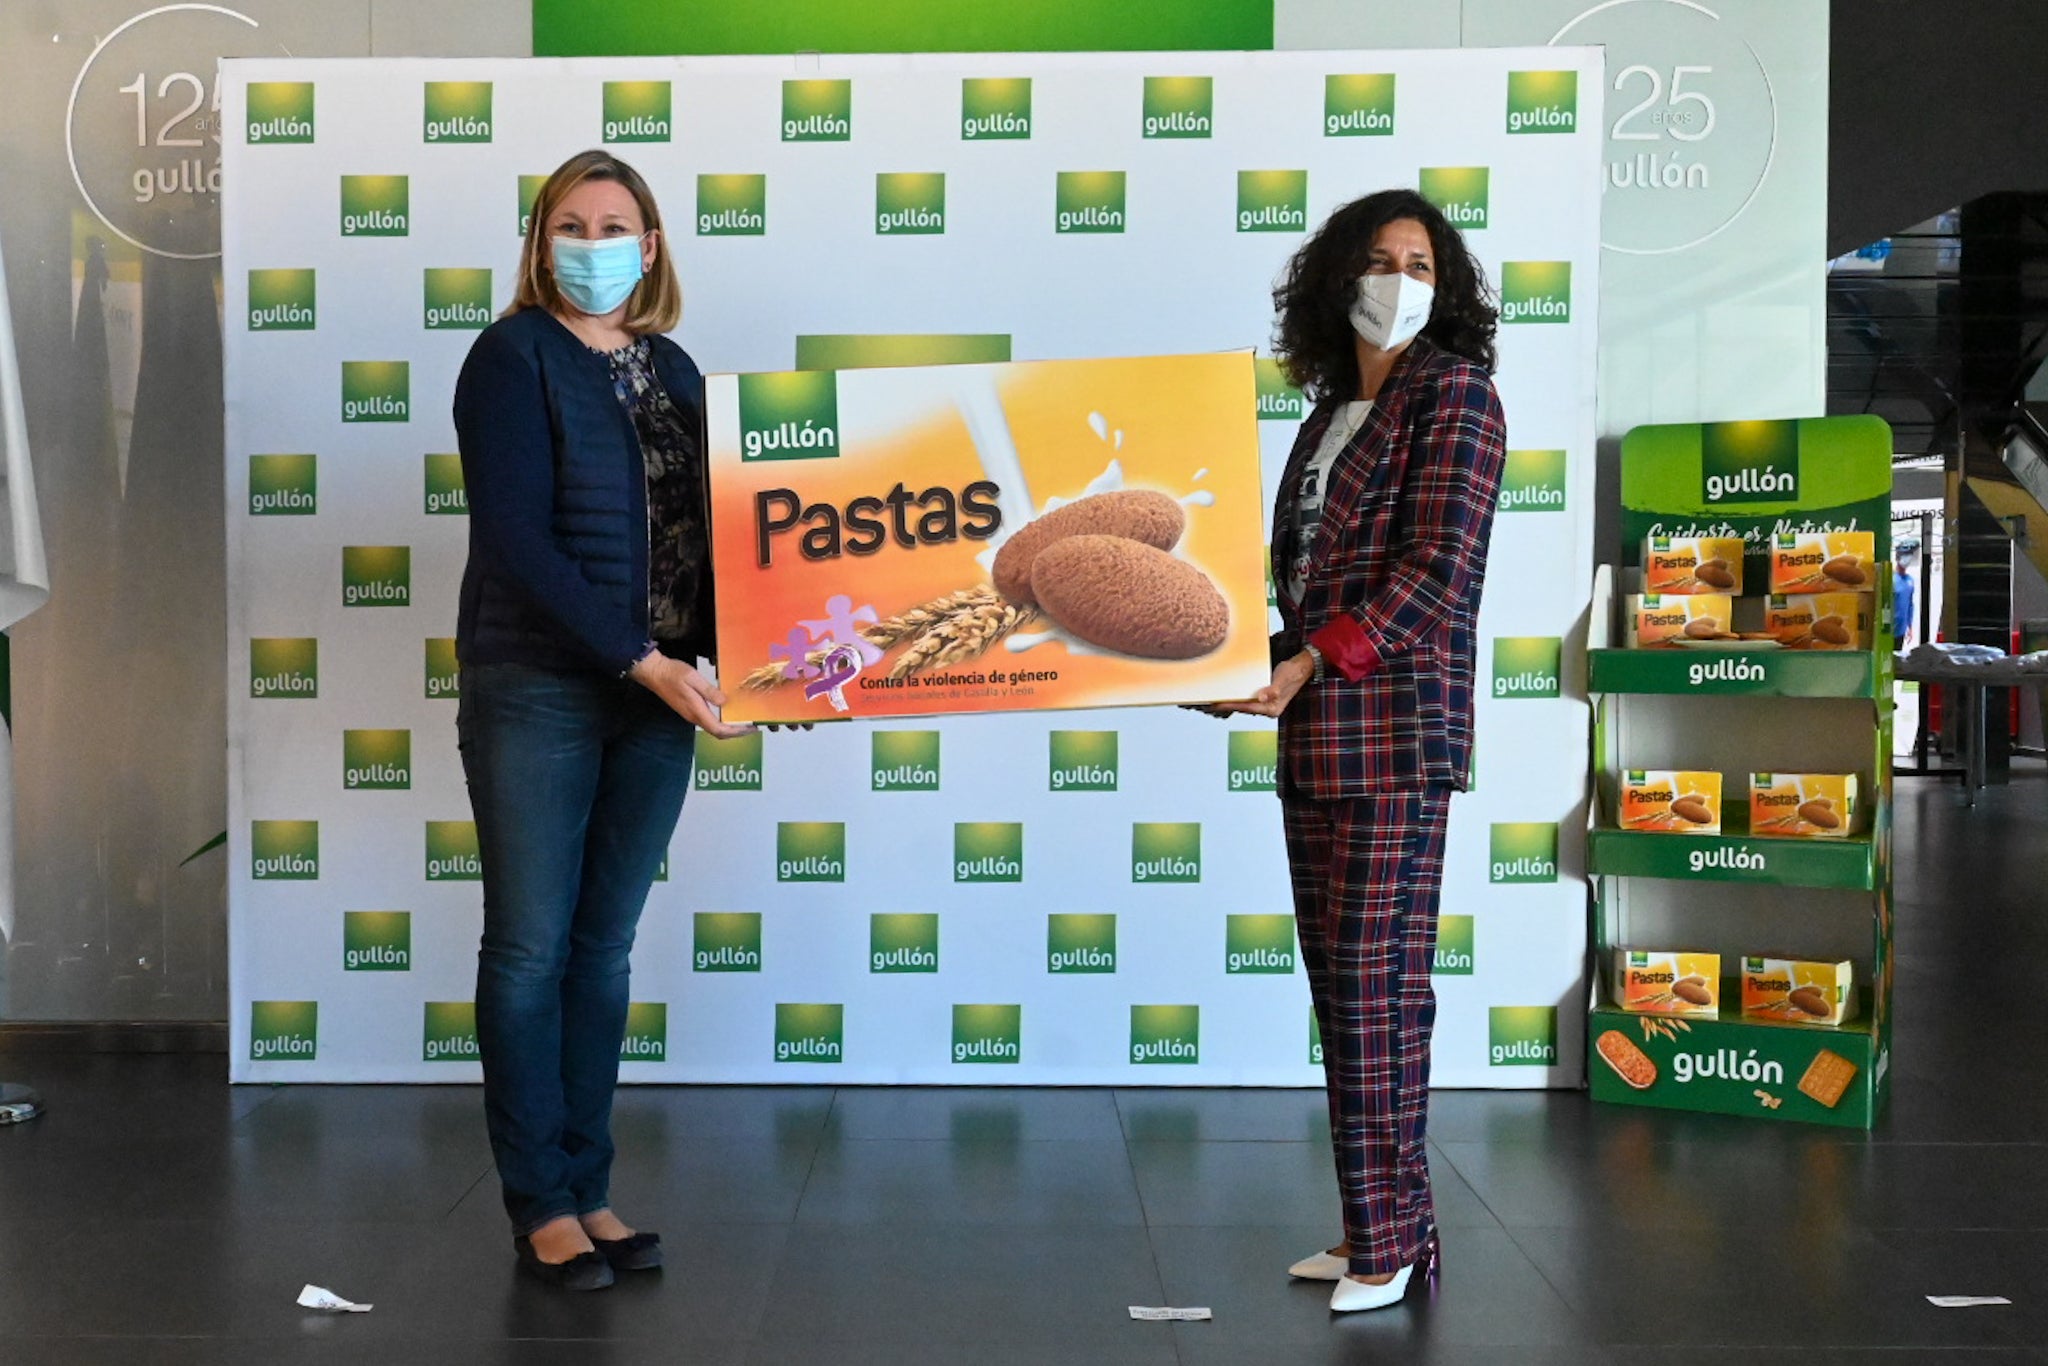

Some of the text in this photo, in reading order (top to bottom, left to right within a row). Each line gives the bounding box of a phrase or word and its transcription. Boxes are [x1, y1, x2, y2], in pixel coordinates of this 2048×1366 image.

[119, 72, 221, 147] 12
[1610, 64, 1716, 142] 25
[251, 116, 310, 141] gullón
[429, 116, 488, 140] gullón
[607, 115, 667, 139] gullón
[785, 114, 847, 138] gullón
[965, 112, 1027, 137] gullón
[1146, 111, 1209, 135] gullón
[1328, 108, 1391, 133] gullón
[1510, 105, 1573, 130] gullón
[132, 156, 221, 203] gulló
[1602, 150, 1709, 196] ullón
[345, 209, 404, 233] gullón
[700, 208, 761, 232] gullón
[879, 207, 941, 231] gullón
[1059, 206, 1121, 230] gullón
[1240, 204, 1303, 229] gullón
[1442, 201, 1485, 222] llón
[252, 303, 311, 327] gullón
[428, 303, 487, 327] gullón
[1504, 296, 1566, 320] gullón
[345, 395, 405, 419] gullón
[1257, 392, 1299, 412] llón
[745, 420, 835, 457] gullón
[1706, 464, 1795, 500] gullón
[254, 488, 312, 511] gullón
[428, 488, 467, 511] gull
[1500, 484, 1562, 508] gullón
[755, 479, 1002, 568] Pastas
[1654, 555, 1697, 569] Pastas
[1780, 552, 1825, 567] Pastas
[347, 579, 406, 603] gullón
[1644, 612, 1687, 627] Pastas
[859, 668, 1058, 690] Contra la violencia de género
[1689, 656, 1766, 685] gullón
[254, 671, 313, 695] gullón
[428, 673, 460, 696] gul
[1495, 671, 1558, 695] gullón
[348, 762, 407, 786] gullón
[698, 763, 759, 787] gullón
[876, 765, 935, 788] gullón
[1053, 765, 1114, 788] gullón
[1231, 763, 1276, 788] gulló
[1629, 789, 1674, 804] Pastas
[256, 854, 314, 877] gullón
[781, 855, 841, 878] gullón
[958, 856, 1019, 879] gullón
[1137, 856, 1197, 879] gullón
[1493, 856, 1555, 880] gullón
[1689, 845, 1766, 872] gullón
[348, 945, 406, 968] gullón
[698, 946, 757, 969] gullón
[875, 946, 935, 969] gullón
[1052, 947, 1112, 970] gullón
[1230, 947, 1292, 971] gullón
[1434, 947, 1471, 968] llón
[1631, 970, 1675, 985] Pastas
[256, 1034, 313, 1057] gullón
[426, 1035, 479, 1059] gulló
[620, 1035, 663, 1055] llón
[780, 1036, 839, 1059] gullón
[957, 1037, 1017, 1060] gullón
[1135, 1038, 1196, 1061] gullón
[1492, 1040, 1554, 1063] gullón
[1673, 1049, 1784, 1084] gullón
